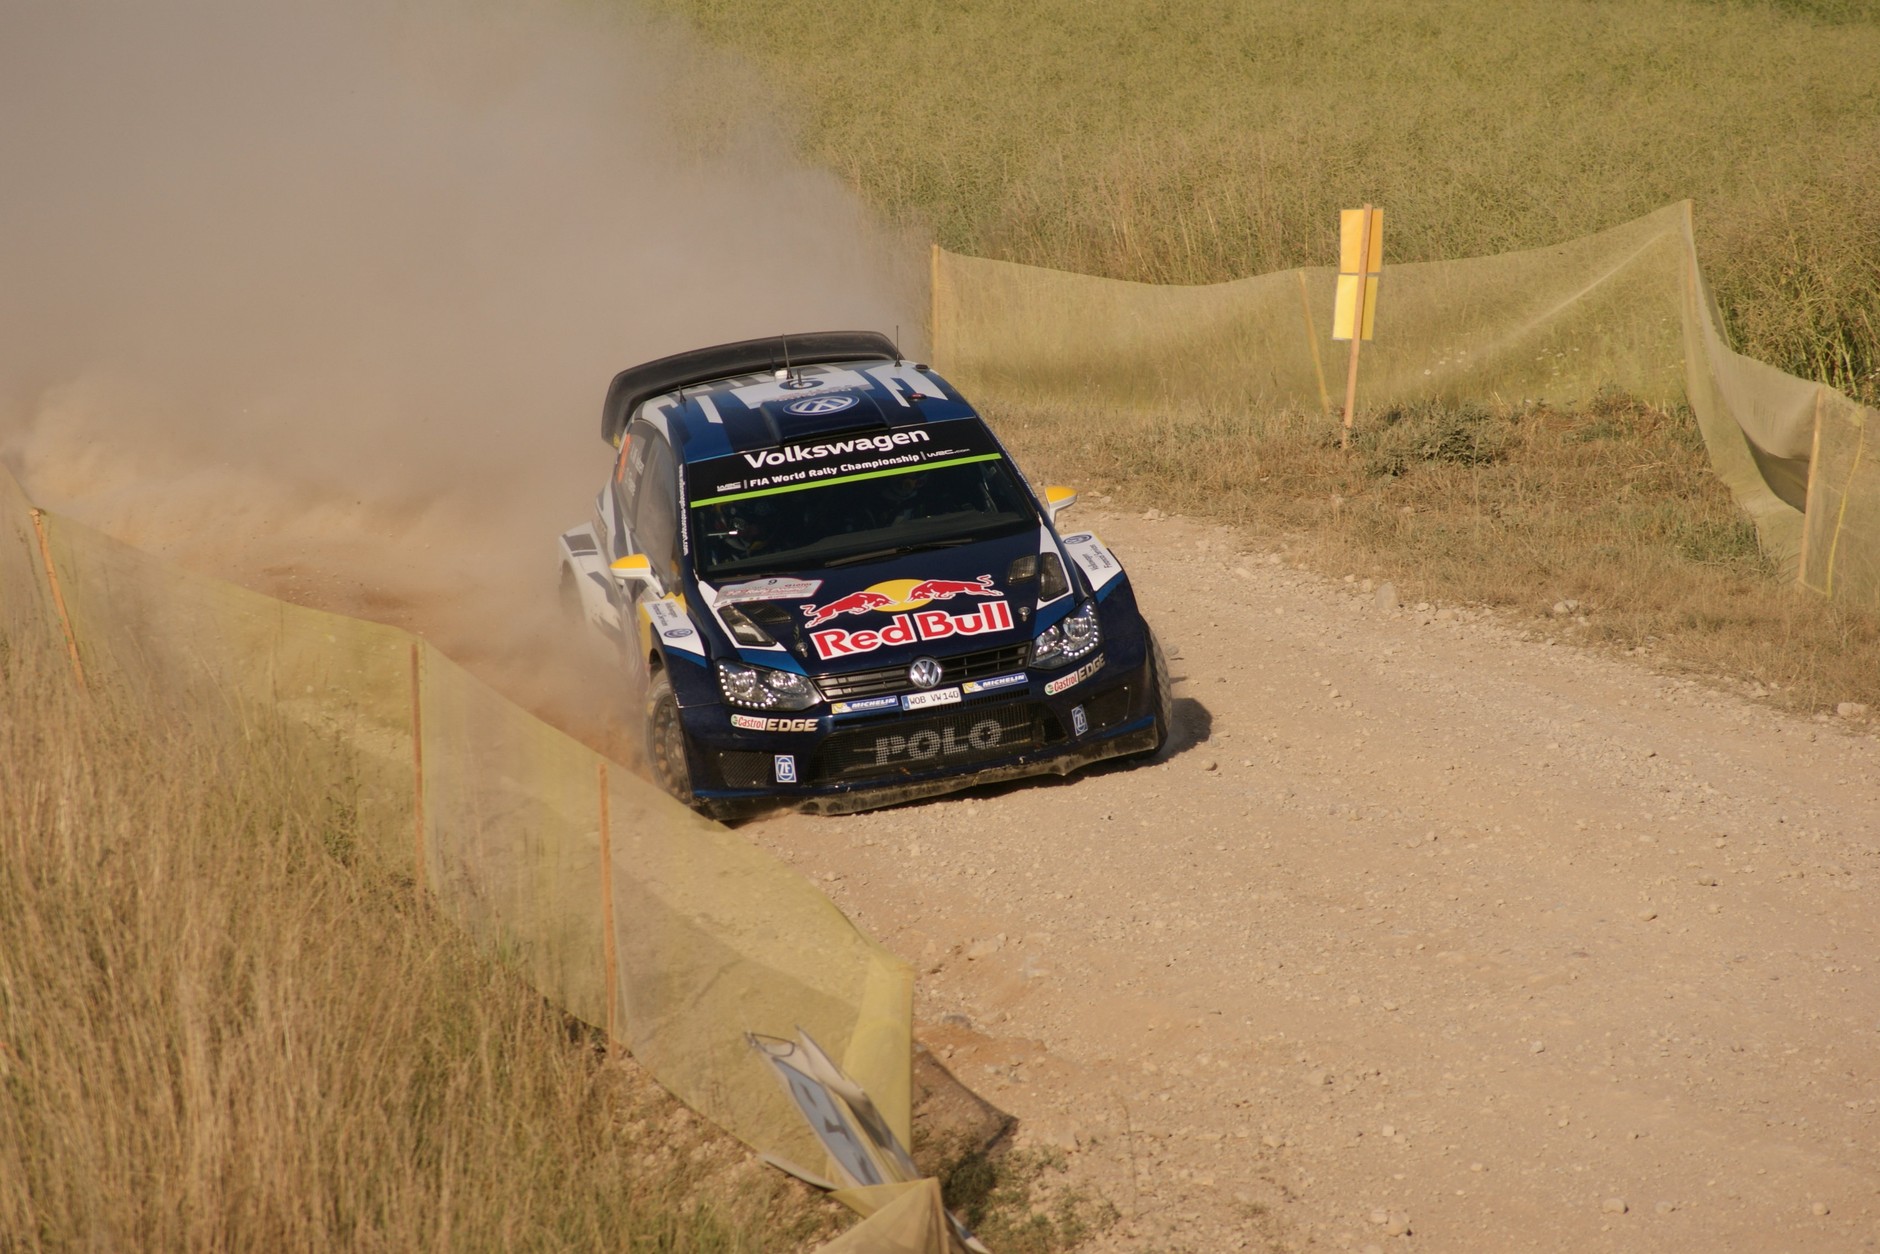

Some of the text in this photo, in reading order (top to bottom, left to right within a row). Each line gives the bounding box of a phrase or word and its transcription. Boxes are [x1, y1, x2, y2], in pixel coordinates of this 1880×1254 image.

[744, 429, 930, 469] Volkswagen
[750, 477, 770, 487] FIA
[771, 471, 806, 483] World
[808, 466, 838, 478] Rally
[840, 454, 920, 473] Championship
[811, 601, 1012, 659] Red Bull
[982, 674, 1025, 688] MICHELIN
[1054, 652, 1106, 692] Castrol EDGE
[851, 697, 896, 709] MICHELIN
[909, 690, 959, 705] WOB VW 140
[737, 716, 820, 732] Castrol EDGE
[876, 718, 1001, 766] POLO
